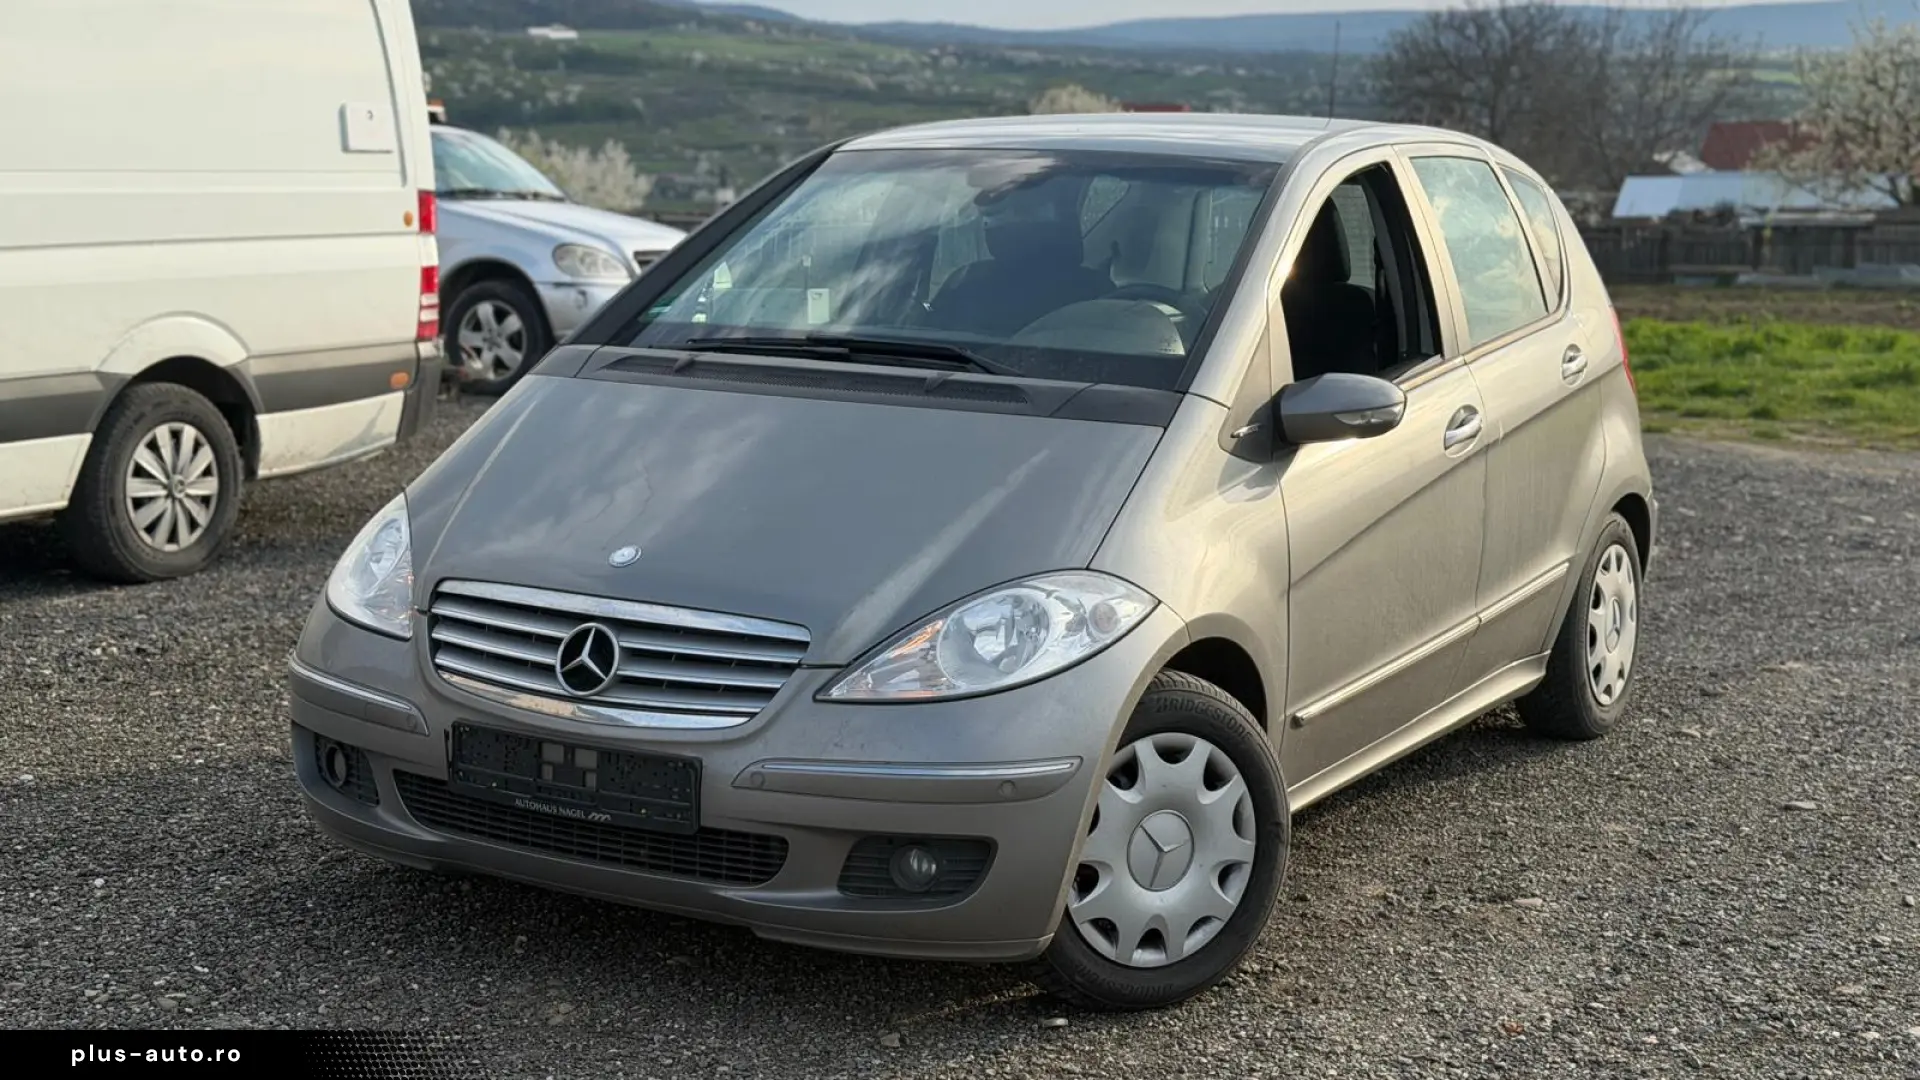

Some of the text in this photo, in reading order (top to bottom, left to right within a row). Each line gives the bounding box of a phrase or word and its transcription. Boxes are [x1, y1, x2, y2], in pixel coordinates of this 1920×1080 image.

[1155, 696, 1253, 740] BRIDGESTONE
[514, 797, 586, 820] AUTOHAUS NAGEL
